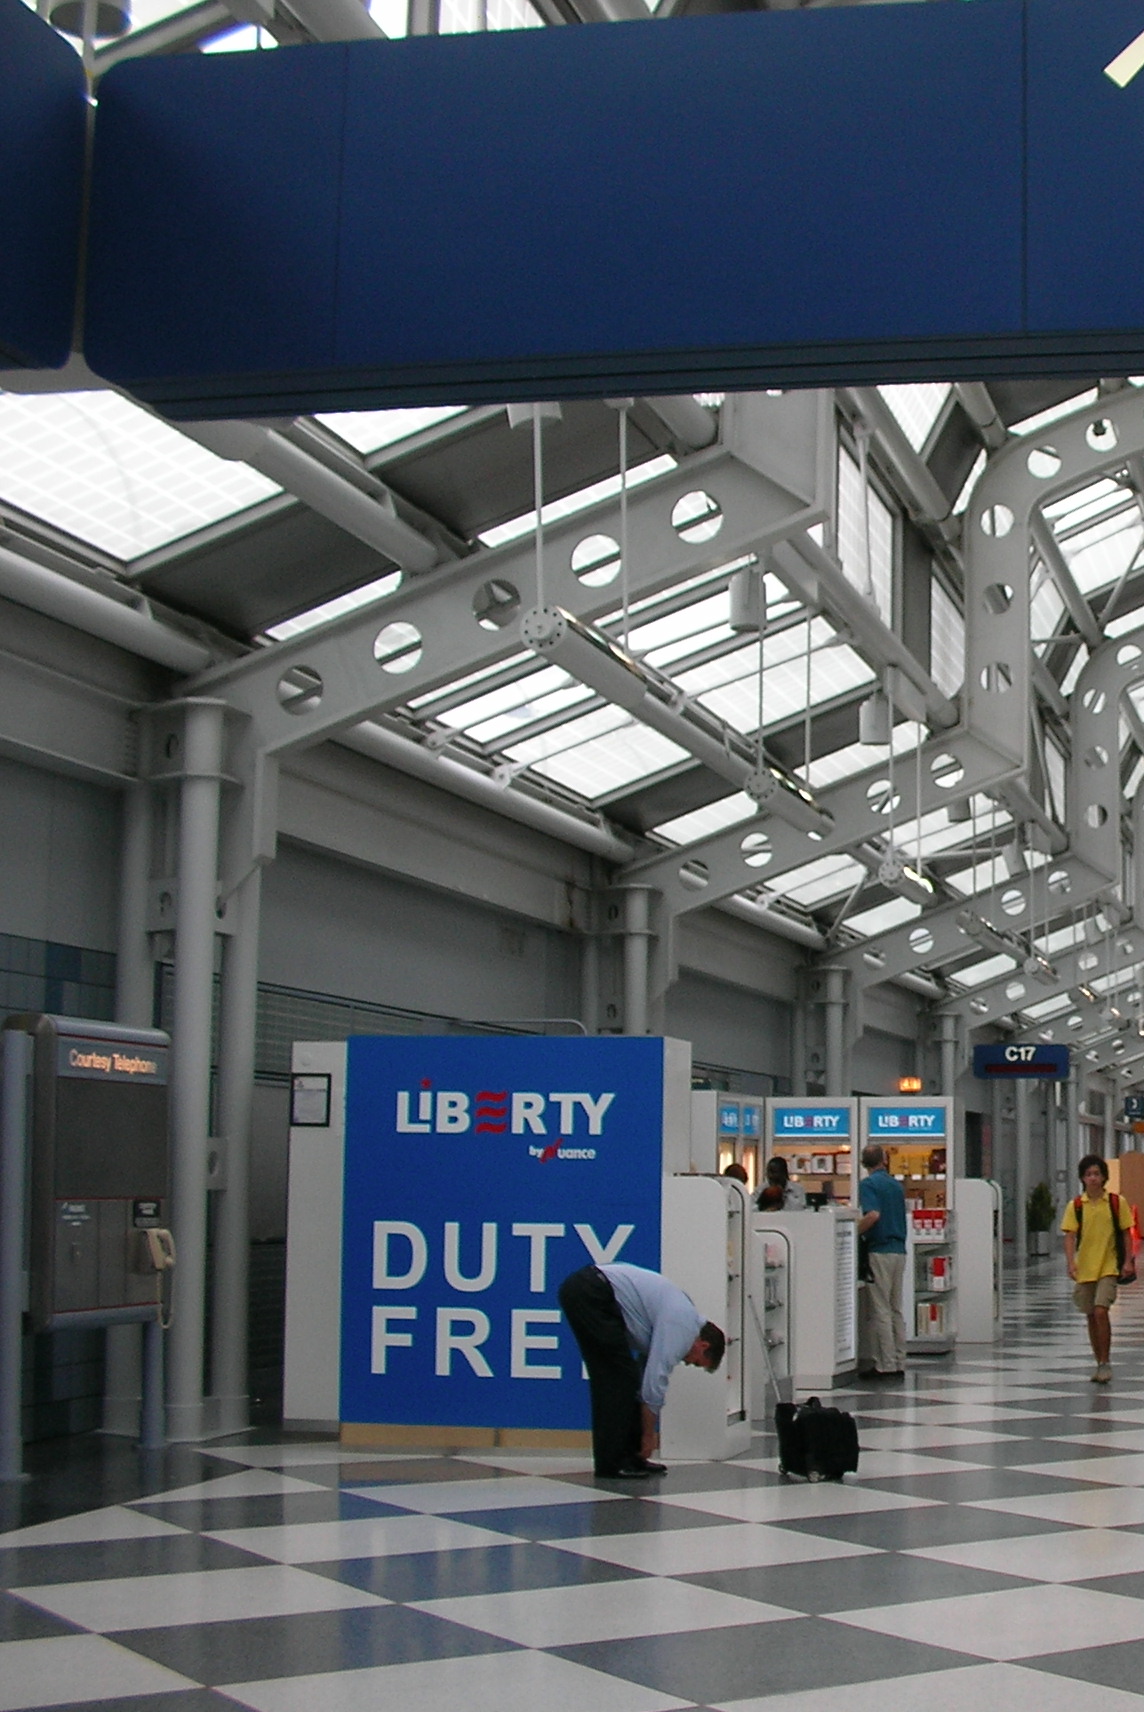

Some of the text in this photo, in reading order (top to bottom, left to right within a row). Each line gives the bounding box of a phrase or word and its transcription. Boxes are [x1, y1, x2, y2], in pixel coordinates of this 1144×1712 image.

[69, 1048, 158, 1075] Courtesy Telephone
[1005, 1046, 1036, 1062] C17
[372, 1220, 636, 1293] DUTY
[370, 1305, 591, 1380] FRE
